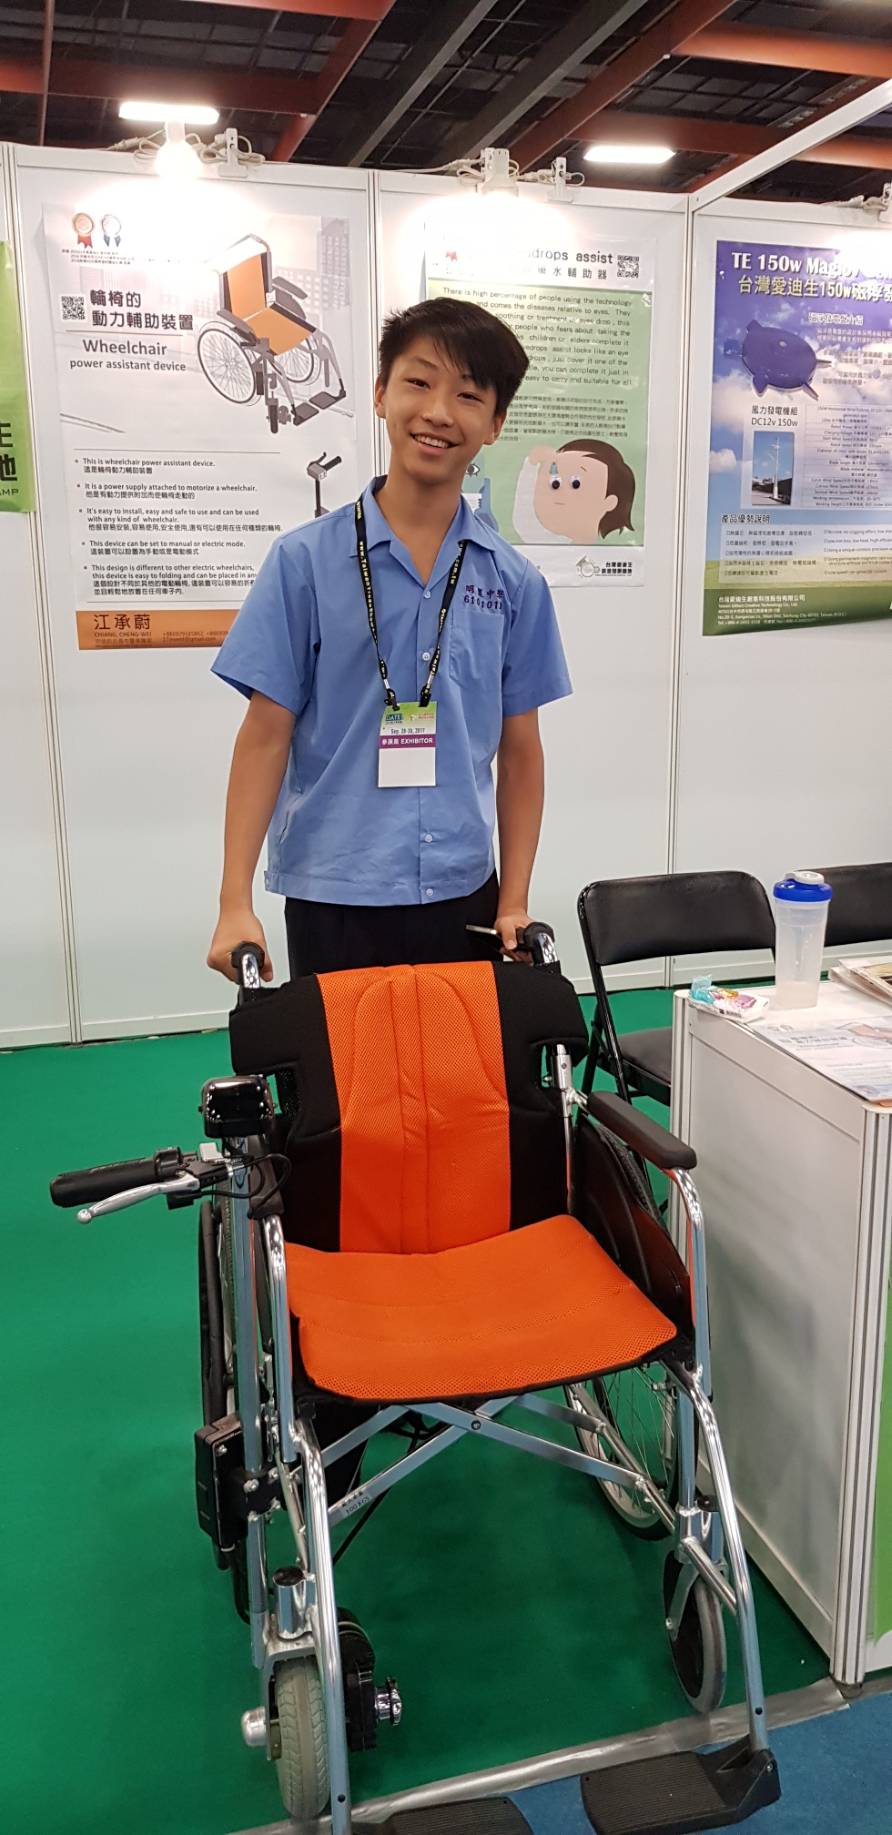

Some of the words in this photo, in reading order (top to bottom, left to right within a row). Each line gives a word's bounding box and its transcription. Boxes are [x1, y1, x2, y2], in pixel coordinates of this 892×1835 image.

[530, 248, 568, 261] drops
[576, 250, 613, 264] assist
[732, 252, 751, 269] TE
[758, 254, 802, 273] 150w
[90, 289, 141, 308] 輪椅的
[473, 289, 487, 297] high
[616, 308, 630, 318] They
[92, 310, 193, 331] 動力輔助裝置
[82, 339, 167, 355] Wheelchair
[70, 359, 103, 369] power
[106, 359, 150, 370] assistant
[153, 360, 186, 371] device
[752, 417, 776, 426] DC12v
[778, 418, 798, 427] 150w
[163, 459, 190, 467] assistant
[106, 564, 128, 572] design
[159, 572, 182, 580] folding
[218, 572, 239, 580] placed
[94, 613, 151, 630] 江承蔚
[400, 737, 433, 745] EXHIBITOR
